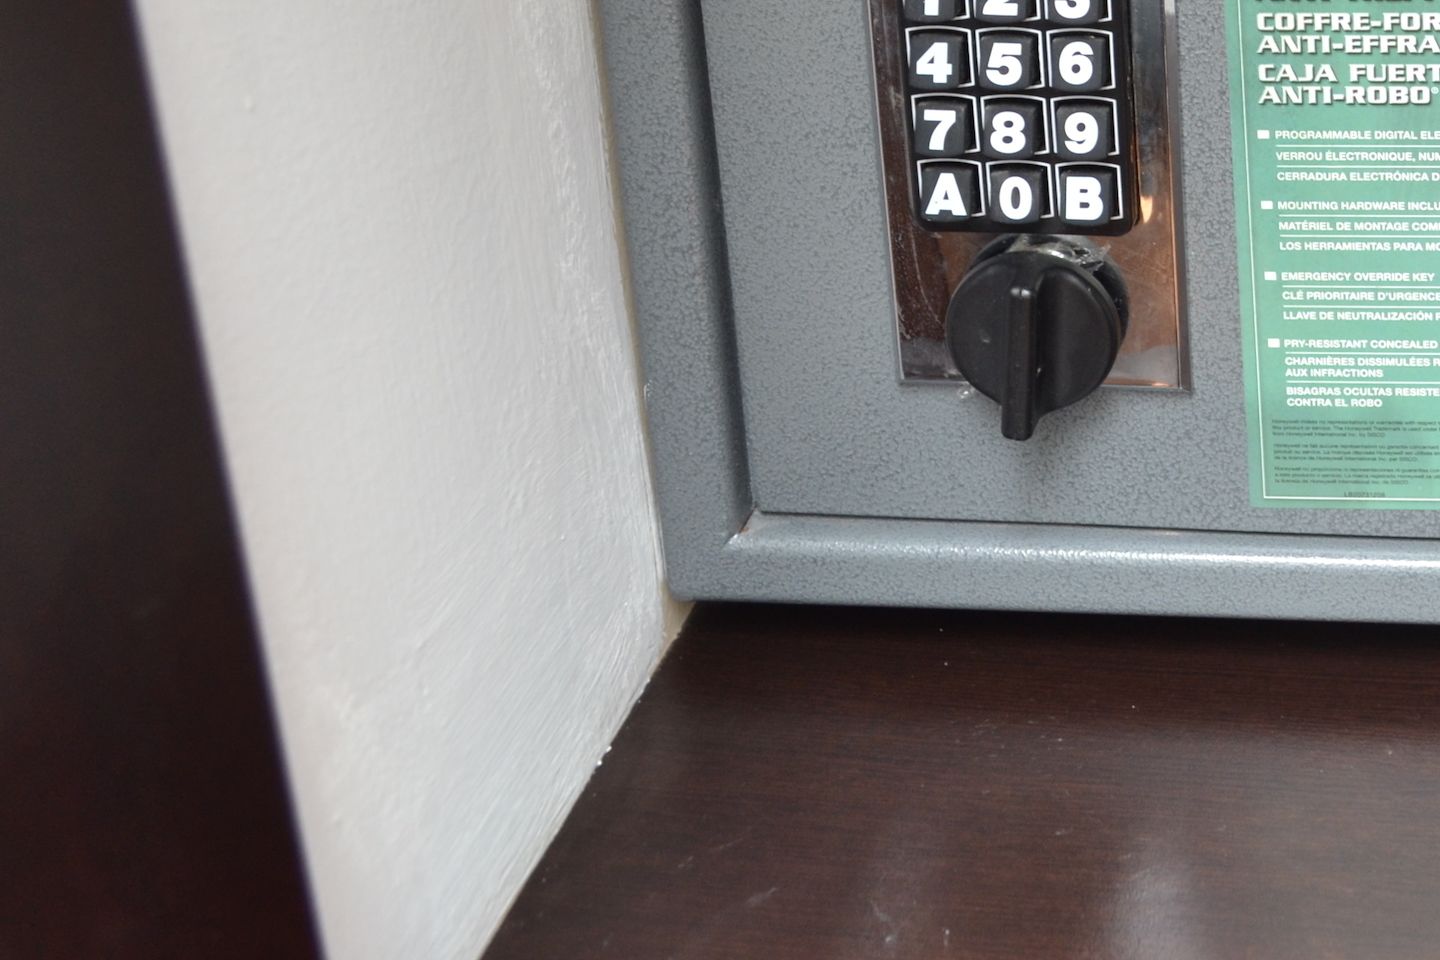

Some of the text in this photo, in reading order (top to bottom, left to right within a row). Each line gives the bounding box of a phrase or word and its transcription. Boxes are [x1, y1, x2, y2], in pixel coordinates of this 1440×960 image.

[915, 41, 1094, 86] 4 5 6
[1258, 64, 1338, 82] CAJA
[923, 109, 1099, 155] 7 8 9
[1275, 130, 1371, 140] PROGRAMMABLE
[1375, 131, 1418, 140] DIGITAL
[1276, 152, 1322, 161] VERROU
[1277, 172, 1347, 182] CERRADURA
[1350, 171, 1429, 182] ELECTRÓNICA
[925, 173, 1104, 220] A 0 B
[1278, 201, 1338, 211] MOUNTING
[1341, 201, 1405, 211] HARDWARE
[1279, 220, 1333, 231] MATÉRIEL
[1336, 222, 1351, 231] DE
[1354, 222, 1409, 231] MONTAGE
[1280, 242, 1302, 251] LOS
[1304, 242, 1391, 251] HERRAMIENTAS
[1394, 242, 1423, 251] PARA
[1281, 272, 1435, 282] EMERGENCY OVERRIDE KEY
[1282, 289, 1303, 300] CLÉ
[1306, 291, 1374, 301] PRIORITAIRE
[1283, 311, 1317, 321] LLAVE
[1319, 311, 1334, 321] DE
[1337, 310, 1433, 321] NEUTRALIZACIÓN
[1284, 339, 1368, 349] PRY-RESISTANT
[1370, 340, 1438, 349] CONCEALED
[1285, 356, 1355, 366] CHARNIÈRES
[1357, 356, 1431, 367] DISSIMULÉES
[1285, 368, 1383, 378] AUX INFRACTIONS
[1286, 387, 1341, 396] BISAGRAS
[1343, 387, 1393, 397] OCULTAS
[1287, 398, 1383, 407] CONTRA EL ROBO
